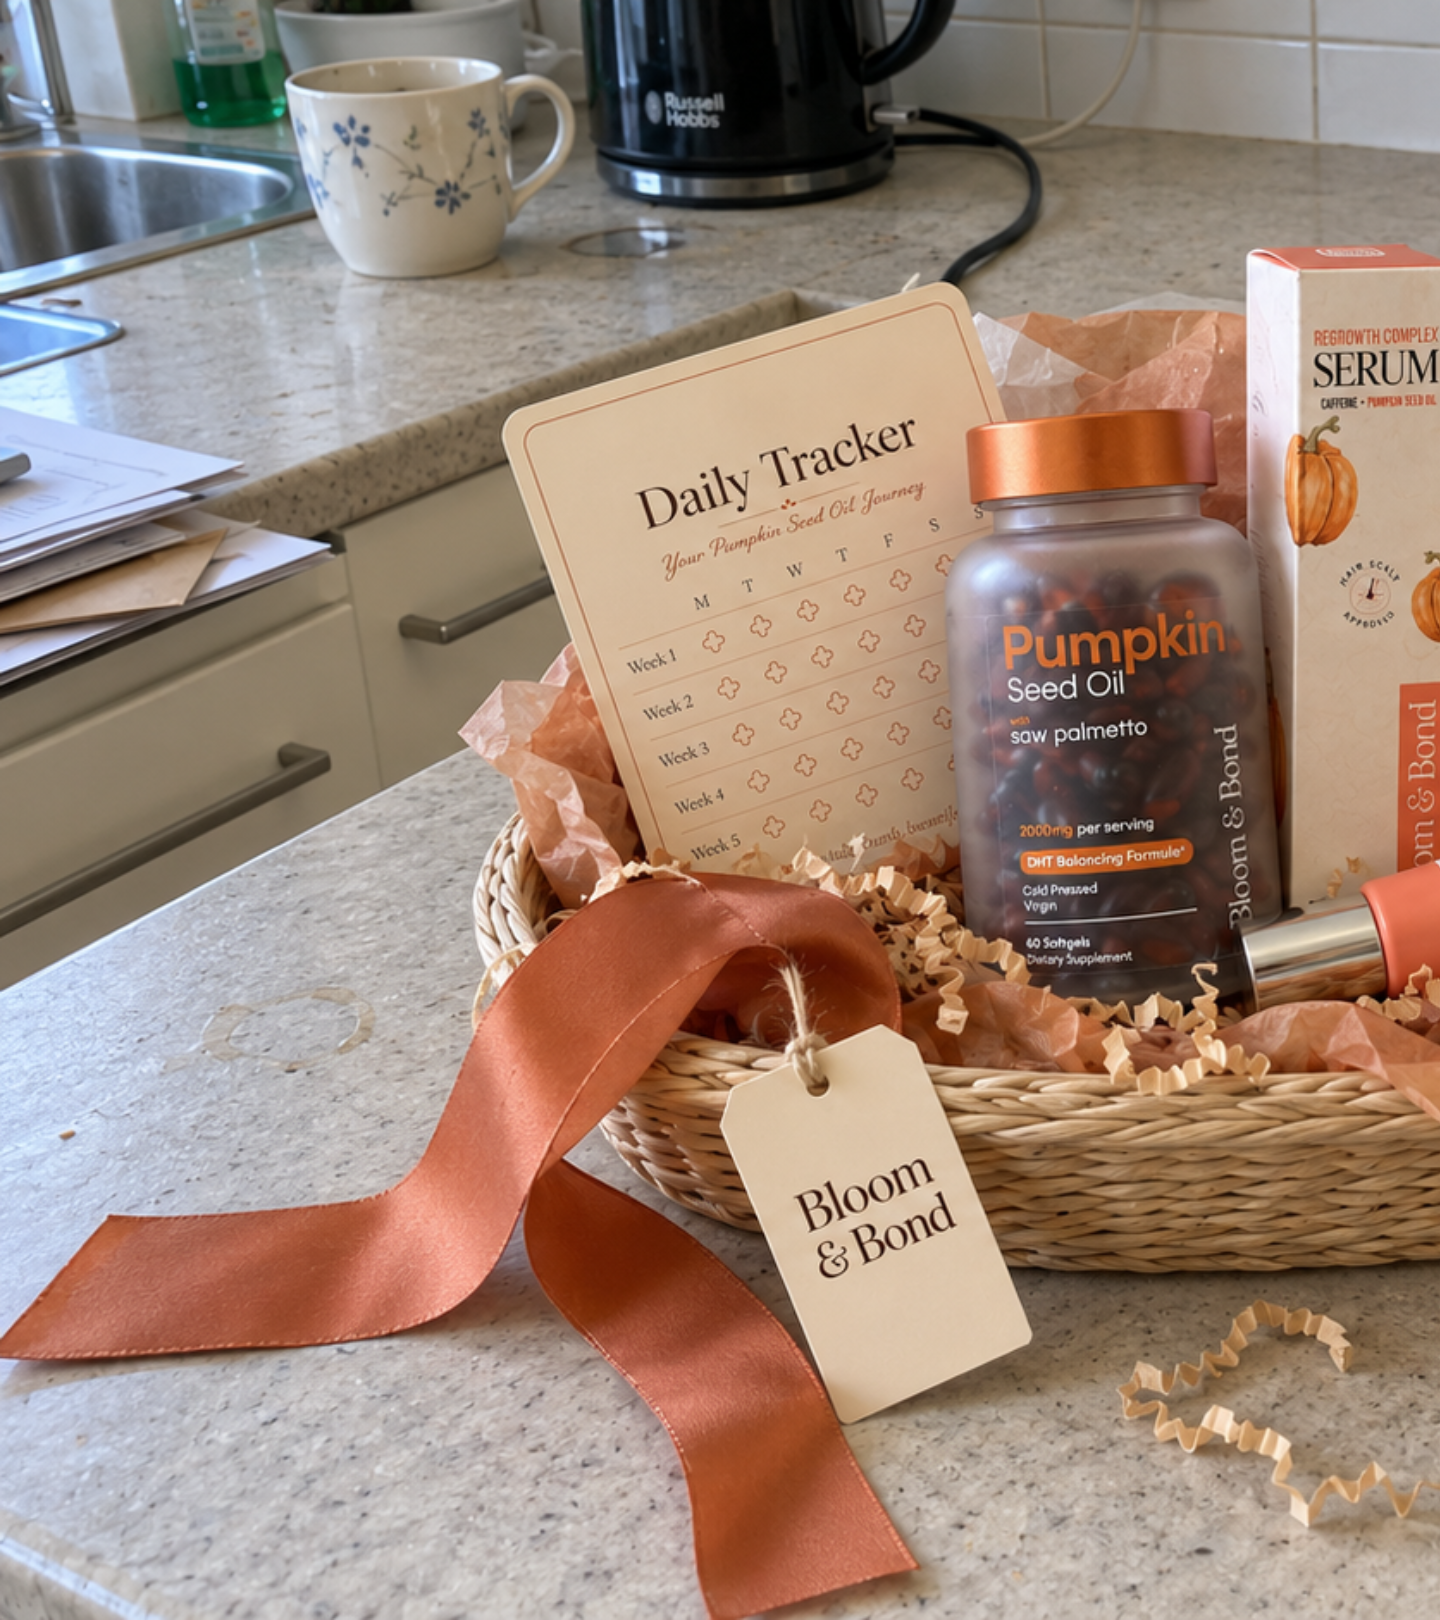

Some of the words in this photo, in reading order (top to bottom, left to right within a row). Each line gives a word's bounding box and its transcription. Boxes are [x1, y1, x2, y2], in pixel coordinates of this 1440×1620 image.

[664, 91, 725, 111] Russell
[665, 110, 720, 128] Hobbs
[1314, 328, 1380, 346] REGROWTH
[1383, 326, 1439, 344] COMPLEX
[1313, 349, 1439, 388] SERUM
[635, 464, 750, 529] Daily
[759, 417, 917, 489] Tracker
[661, 552, 705, 582] Your
[709, 525, 782, 557] Pumpkin
[786, 507, 824, 534] Seed
[829, 496, 857, 519] Oil
[861, 482, 926, 515] Journey
[693, 594, 711, 610] M
[742, 578, 754, 593] T
[787, 562, 804, 577] W
[835, 548, 848, 562] T
[883, 533, 893, 547] F
[928, 518, 940, 532] S
[974, 505, 984, 519] S
[1002, 610, 1226, 675] Pumpkin
[627, 653, 667, 675] Week
[669, 648, 677, 663] 1
[1008, 673, 1077, 703] Seed
[1087, 669, 1125, 697] Oil
[643, 699, 681, 721] Week
[682, 694, 694, 709] 2
[1010, 728, 1047, 744] saw
[1055, 719, 1148, 747] palmetto
[1408, 699, 1437, 782] Bond
[658, 747, 697, 769] Week
[698, 741, 710, 756] 3
[1213, 723, 1242, 801] Bond
[674, 793, 714, 815] Week
[714, 788, 725, 802] 4
[1407, 787, 1435, 813] &
[1019, 824, 1073, 839] 2000mg
[1077, 823, 1101, 838] per
[1104, 818, 1154, 834] serving
[1221, 806, 1244, 829] &
[690, 840, 730, 862] Week
[731, 834, 742, 849] 5
[1027, 856, 1053, 868] DHT
[1056, 851, 1123, 867] Balancing
[1228, 834, 1253, 930] Bloom
[1025, 937, 1040, 949] 60
[1066, 951, 1133, 966] Supplement
[794, 1158, 935, 1233] Bloom
[817, 1240, 849, 1279] &
[848, 1191, 958, 1266] Bond
